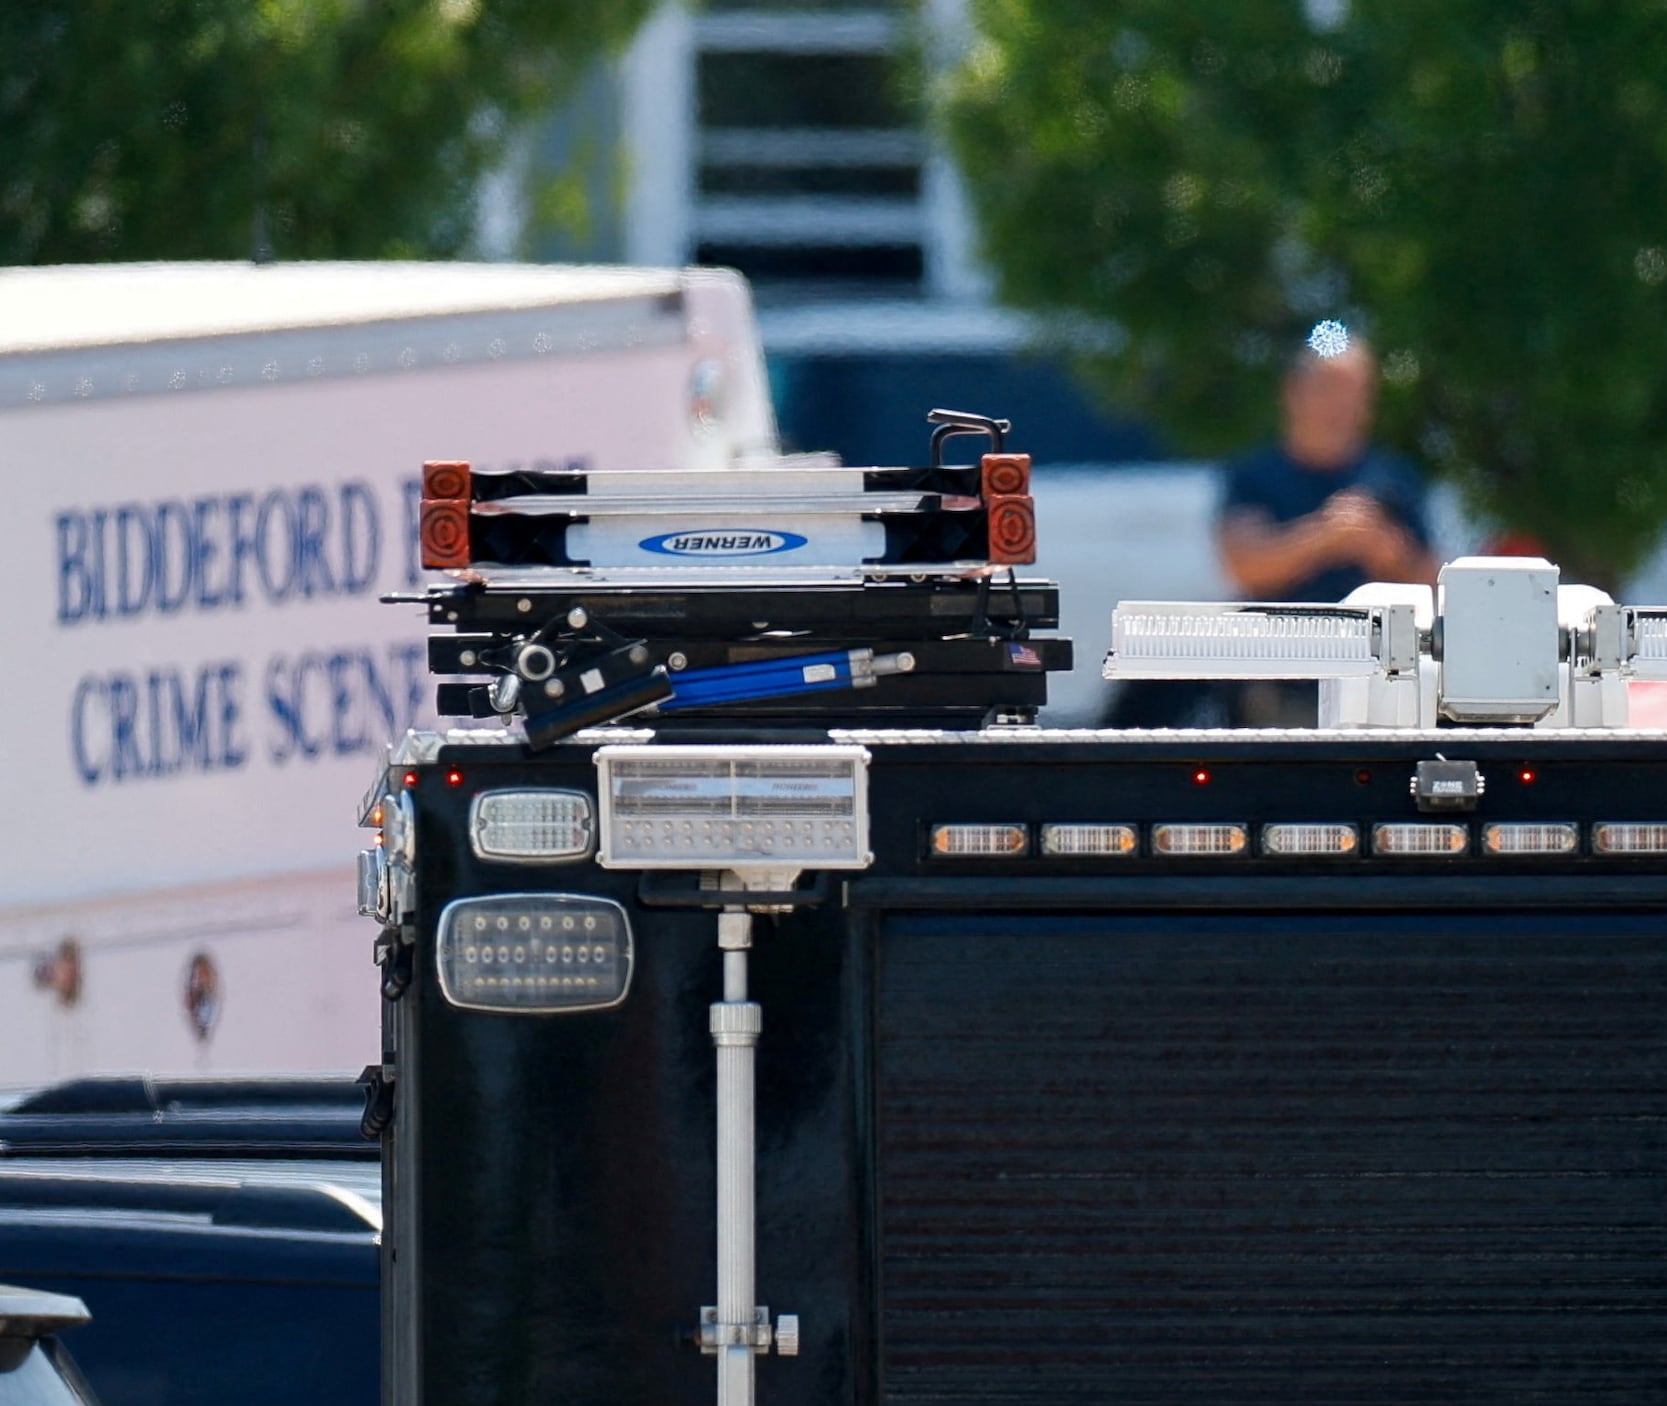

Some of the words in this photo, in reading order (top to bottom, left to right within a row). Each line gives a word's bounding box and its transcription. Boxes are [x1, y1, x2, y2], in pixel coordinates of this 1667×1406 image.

[55, 479, 381, 628] BIDDEFORD
[673, 535, 772, 551] WERNER
[71, 657, 246, 790] CRIME
[264, 640, 426, 765] SCEN
